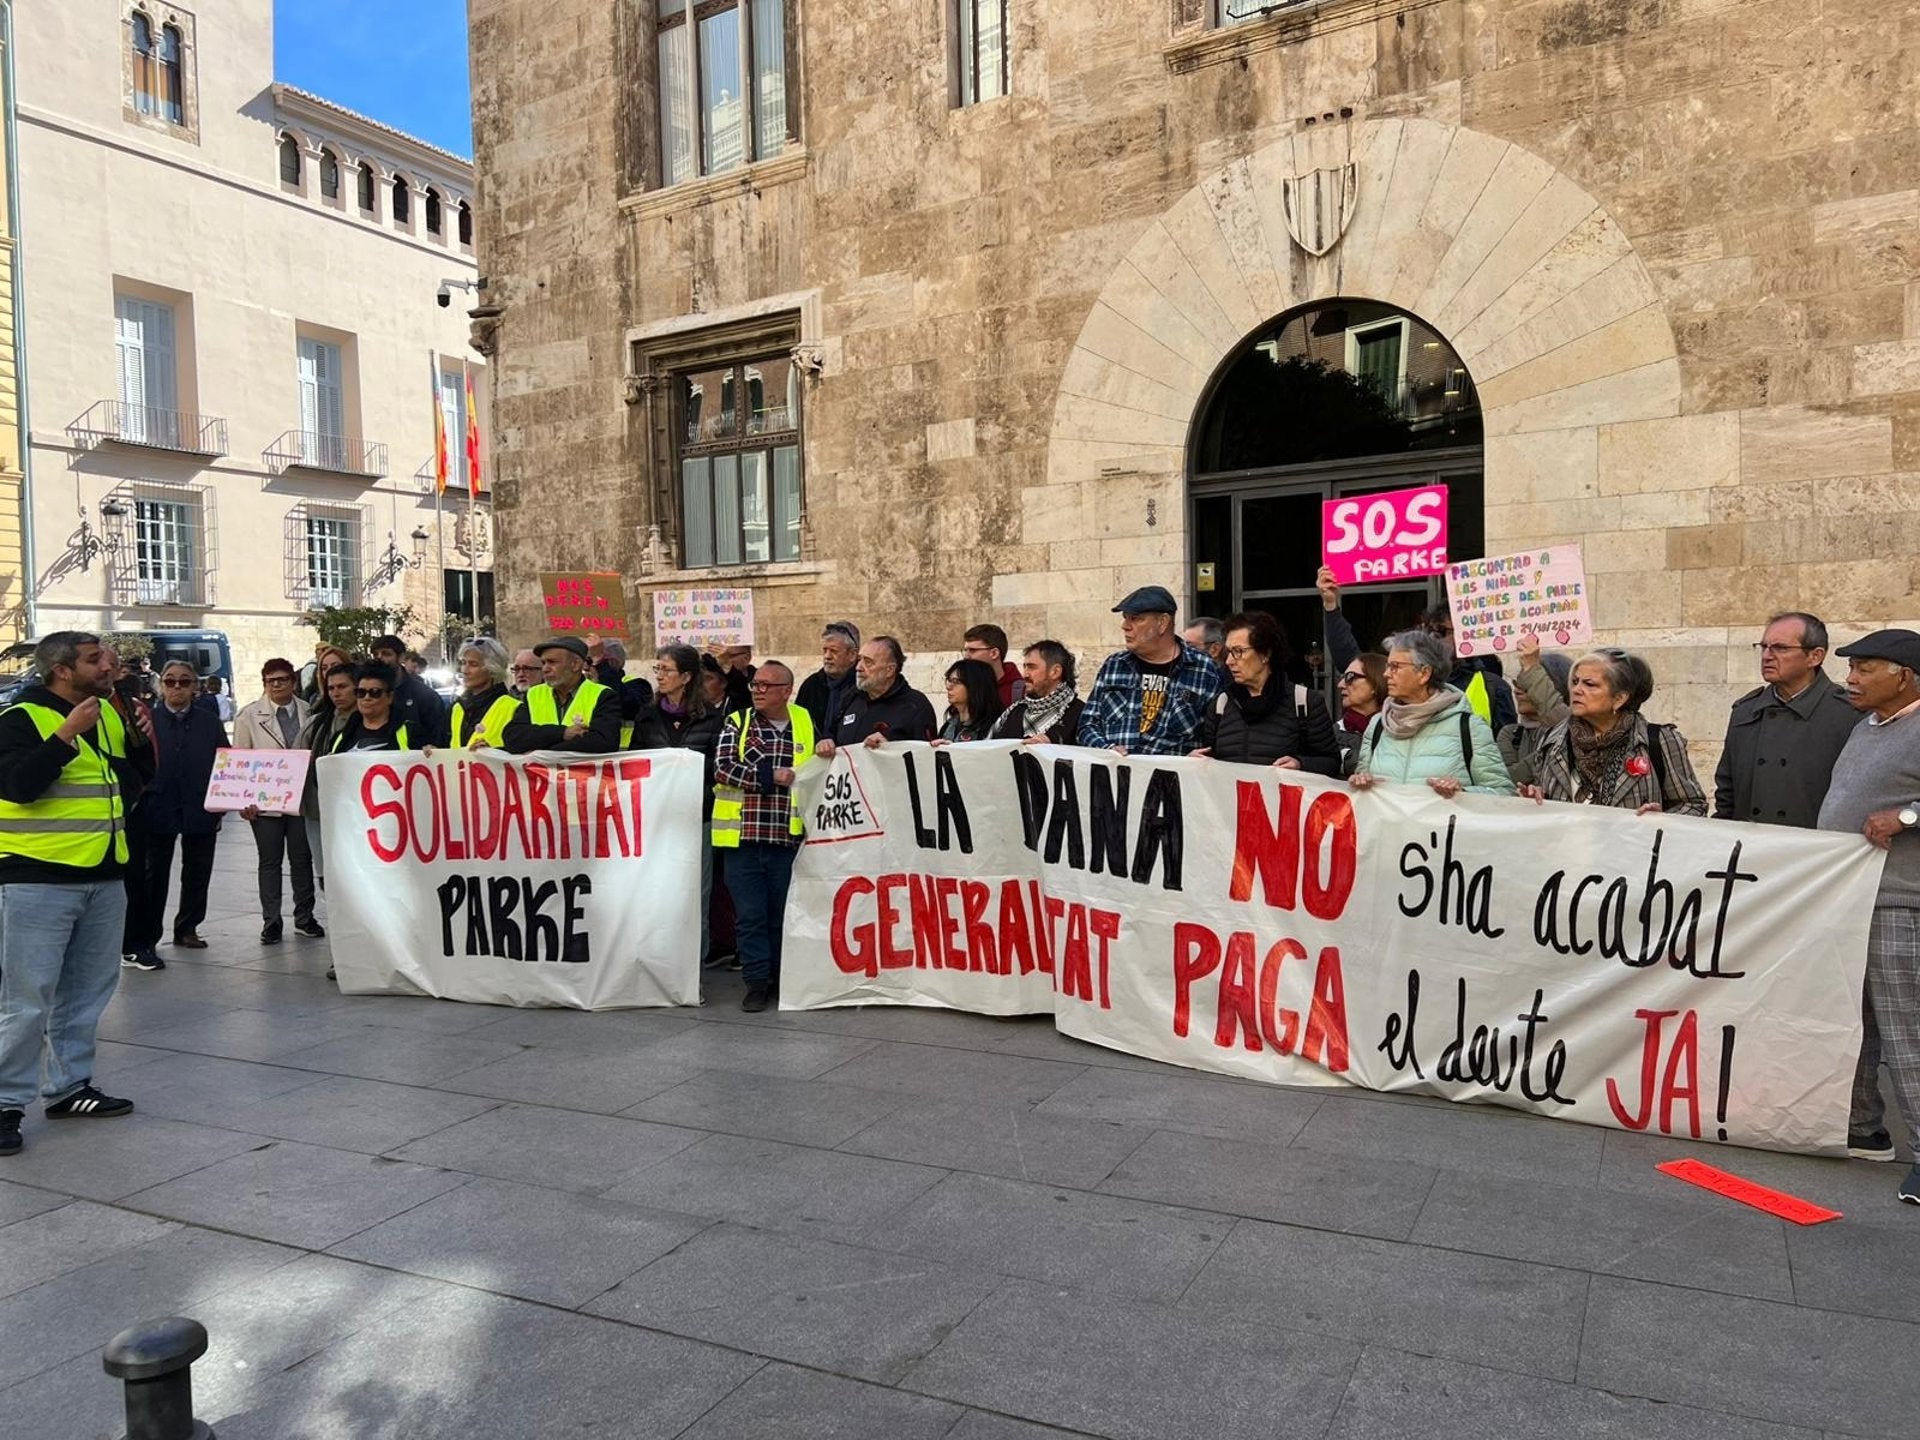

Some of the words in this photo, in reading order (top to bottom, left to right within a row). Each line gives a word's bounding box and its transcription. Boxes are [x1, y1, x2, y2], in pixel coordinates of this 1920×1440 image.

[1353, 547, 1447, 582] PARKE
[1451, 556, 1531, 580] PREGUNTAD
[1540, 552, 1550, 565] A
[557, 578, 594, 594] NOS
[658, 591, 685, 604] NOS
[1455, 582, 1478, 596] LAS
[1485, 574, 1524, 591] NIÑAS
[1456, 592, 1510, 612] JÓVENES
[1519, 590, 1543, 602] DEL
[1546, 583, 1581, 599] PARKE
[664, 605, 687, 617] CON
[693, 604, 708, 615] LA
[1520, 599, 1579, 619] ACOMPAÑA
[1462, 627, 1495, 640] DESDE
[1500, 624, 1515, 637] EL
[824, 772, 852, 800] SOS
[360, 758, 651, 864] SOLIDARITAT
[816, 801, 864, 830] PARKE
[903, 750, 973, 855] LA
[1010, 749, 1184, 891] DANA
[1229, 779, 1358, 922] NO
[1534, 828, 1759, 979] acabat
[436, 873, 592, 962] PARKE
[829, 872, 1122, 1010] GENERALTAT
[1174, 921, 1350, 1073] PAGA
[1377, 969, 1425, 1080] el
[1436, 977, 1577, 1105] deute
